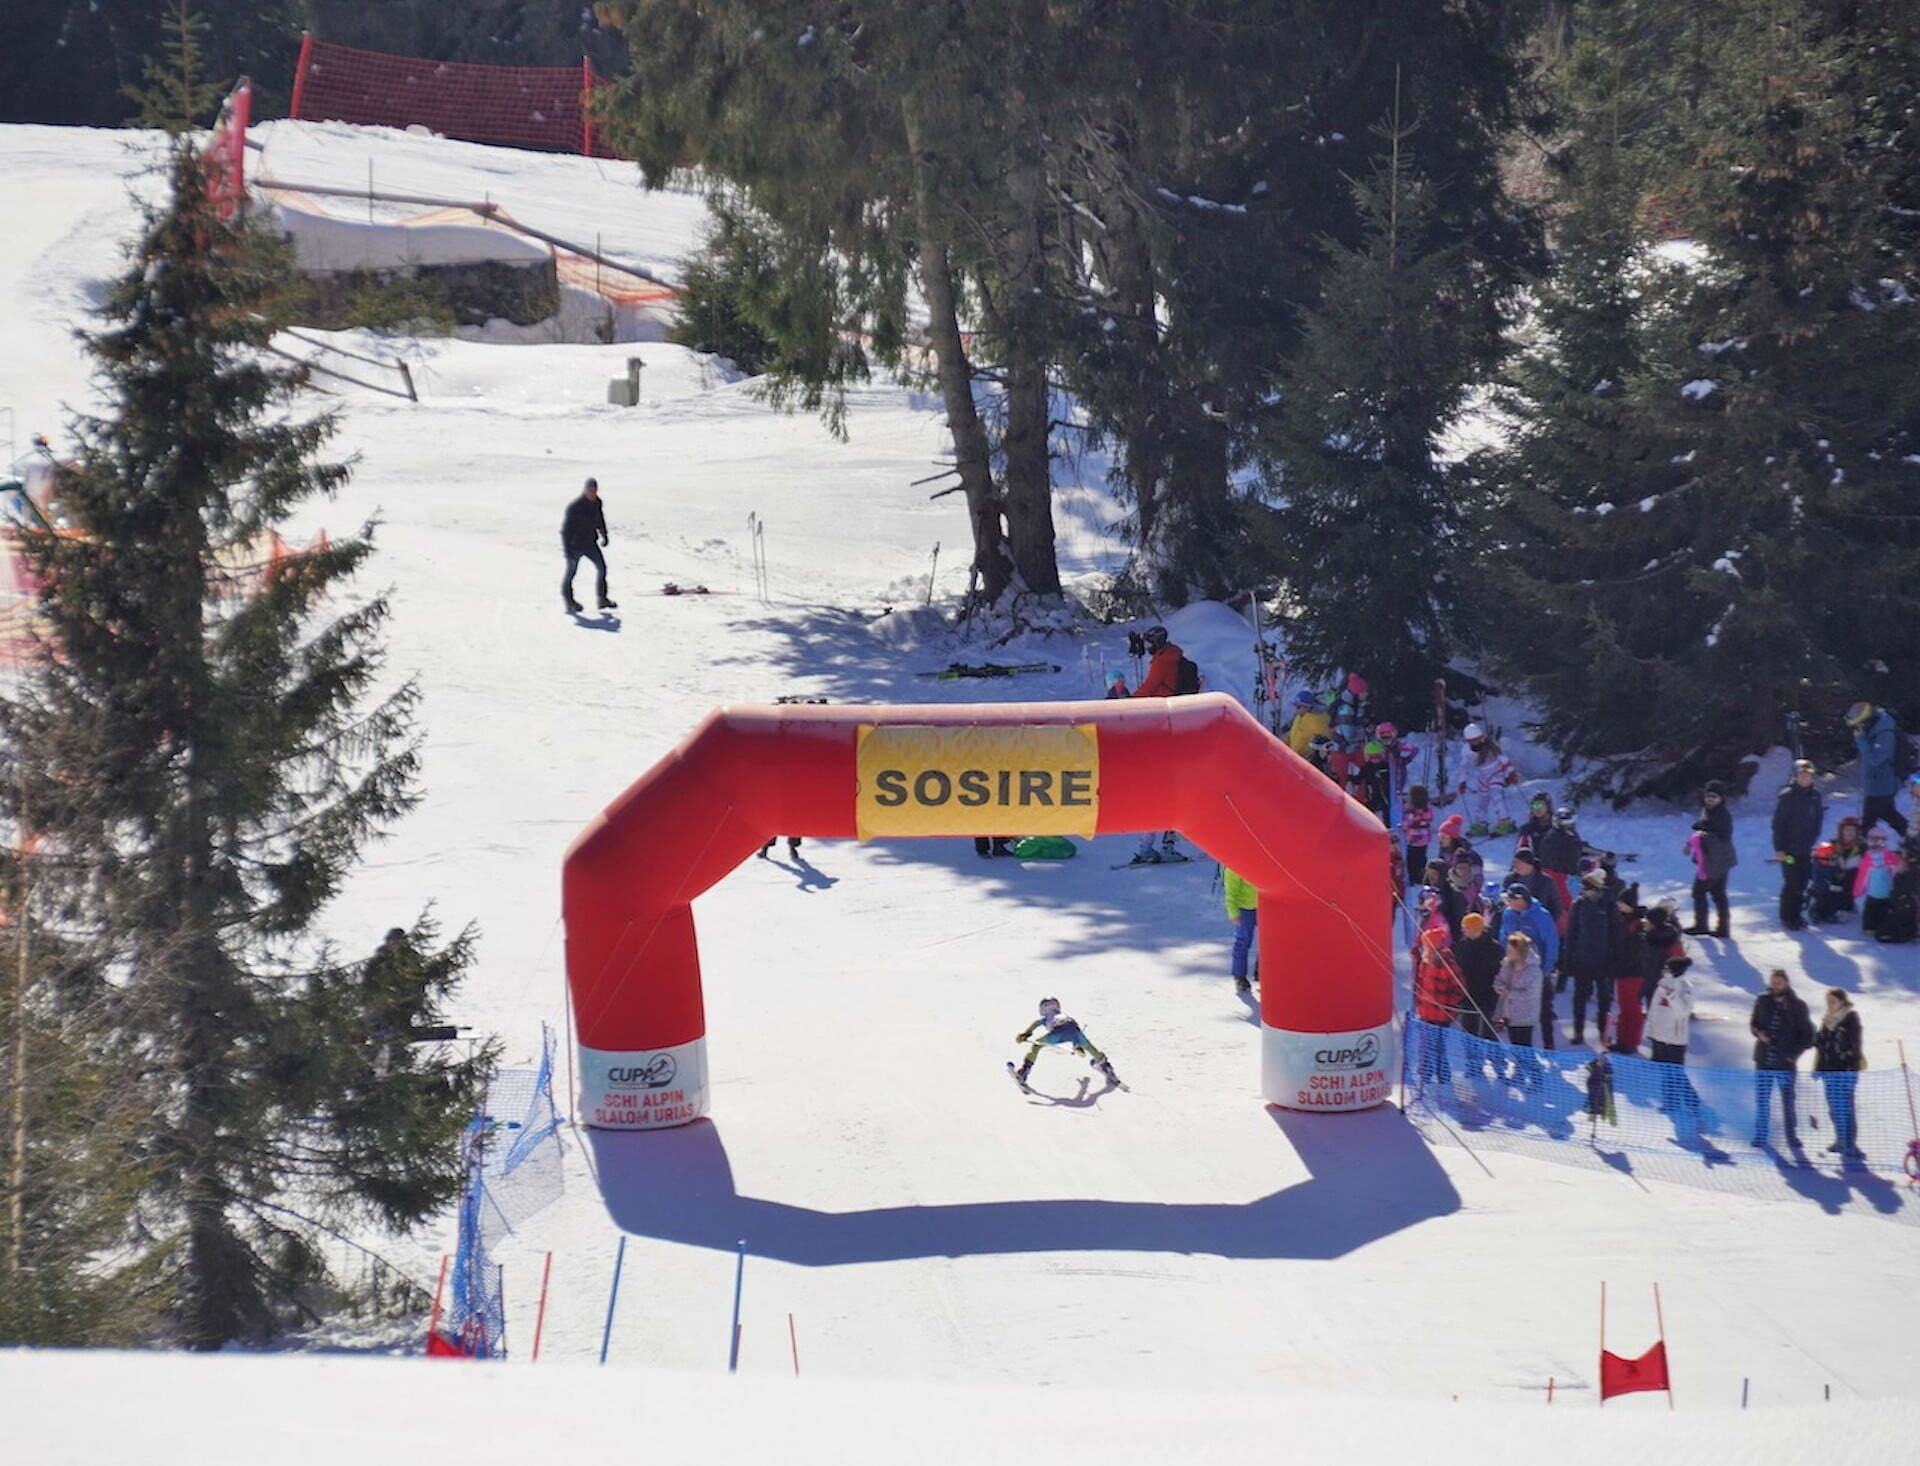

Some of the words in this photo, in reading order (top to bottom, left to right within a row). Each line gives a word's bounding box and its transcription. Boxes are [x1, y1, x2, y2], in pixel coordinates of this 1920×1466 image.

[874, 769, 1092, 806] SOSIRE
[1315, 1048, 1362, 1064] CUPA
[608, 1067, 654, 1081] CUPA
[1309, 1075, 1345, 1090] SCHI
[1349, 1070, 1385, 1087] ALPIN
[603, 1093, 637, 1107] SCHI
[642, 1089, 684, 1107] ALPIN
[1297, 1090, 1356, 1106] SLALOM
